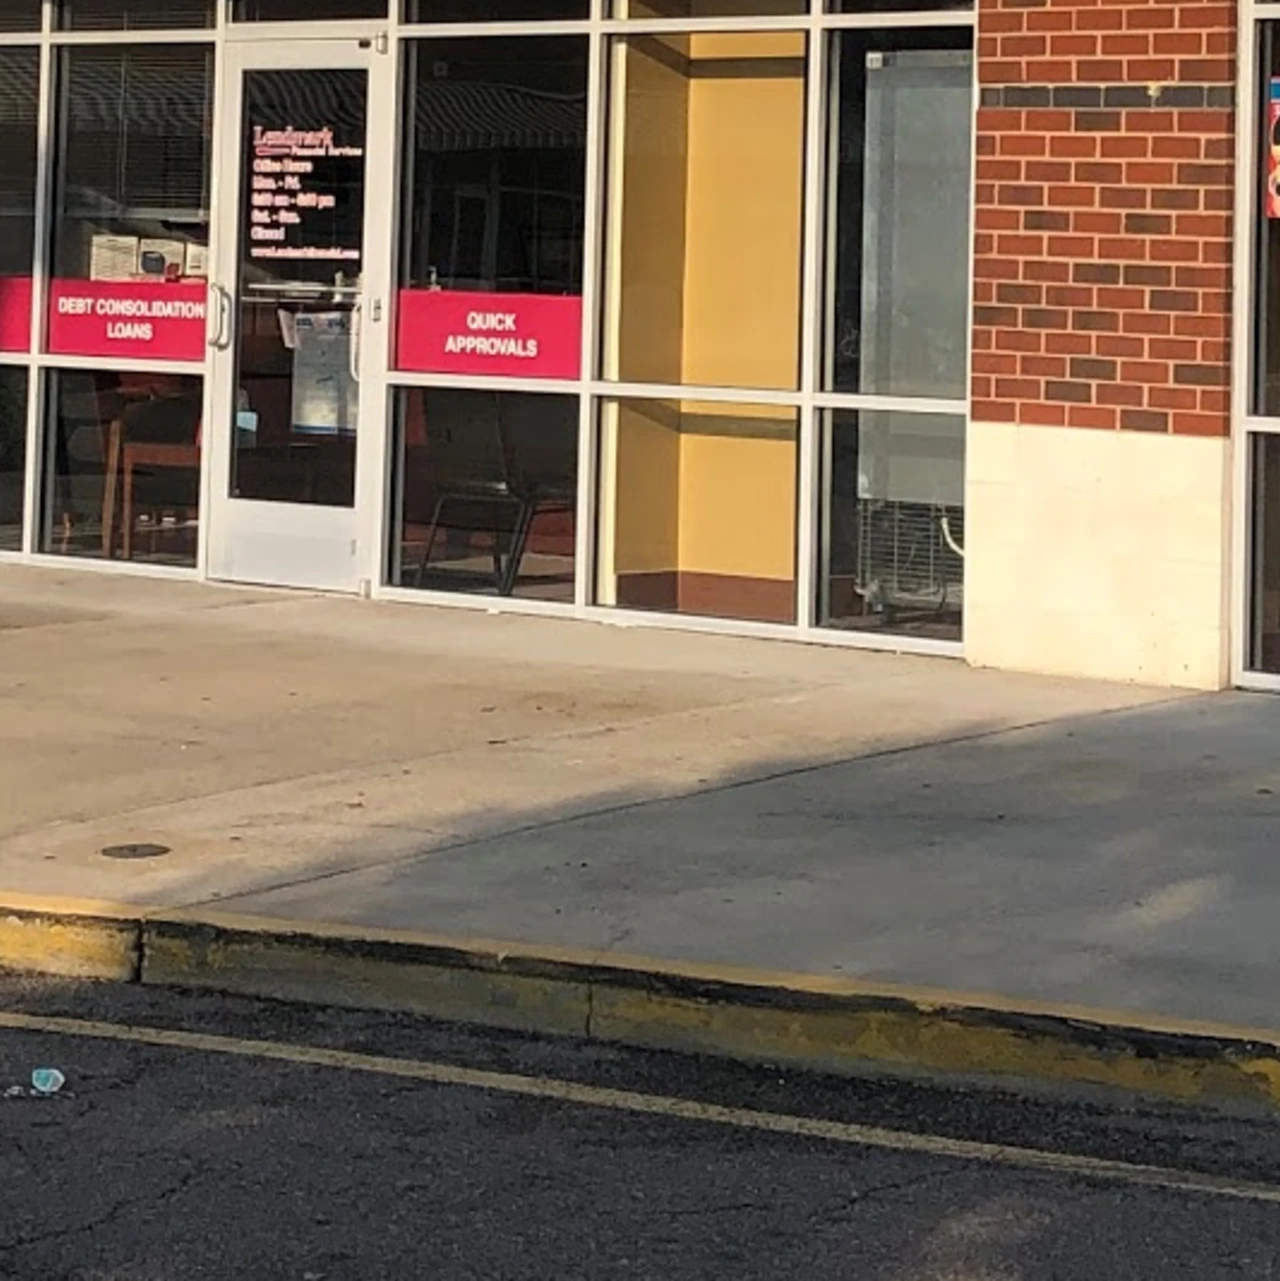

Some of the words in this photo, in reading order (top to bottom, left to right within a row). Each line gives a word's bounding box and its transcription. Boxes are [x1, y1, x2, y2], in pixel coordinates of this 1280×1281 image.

[253, 125, 334, 148] Lendmark
[57, 296, 95, 314] DEBT
[95, 298, 206, 319] CONSOLIDATION
[106, 322, 154, 340] LOANS
[466, 310, 517, 332] QUICK
[444, 333, 538, 358] APPROVALS
